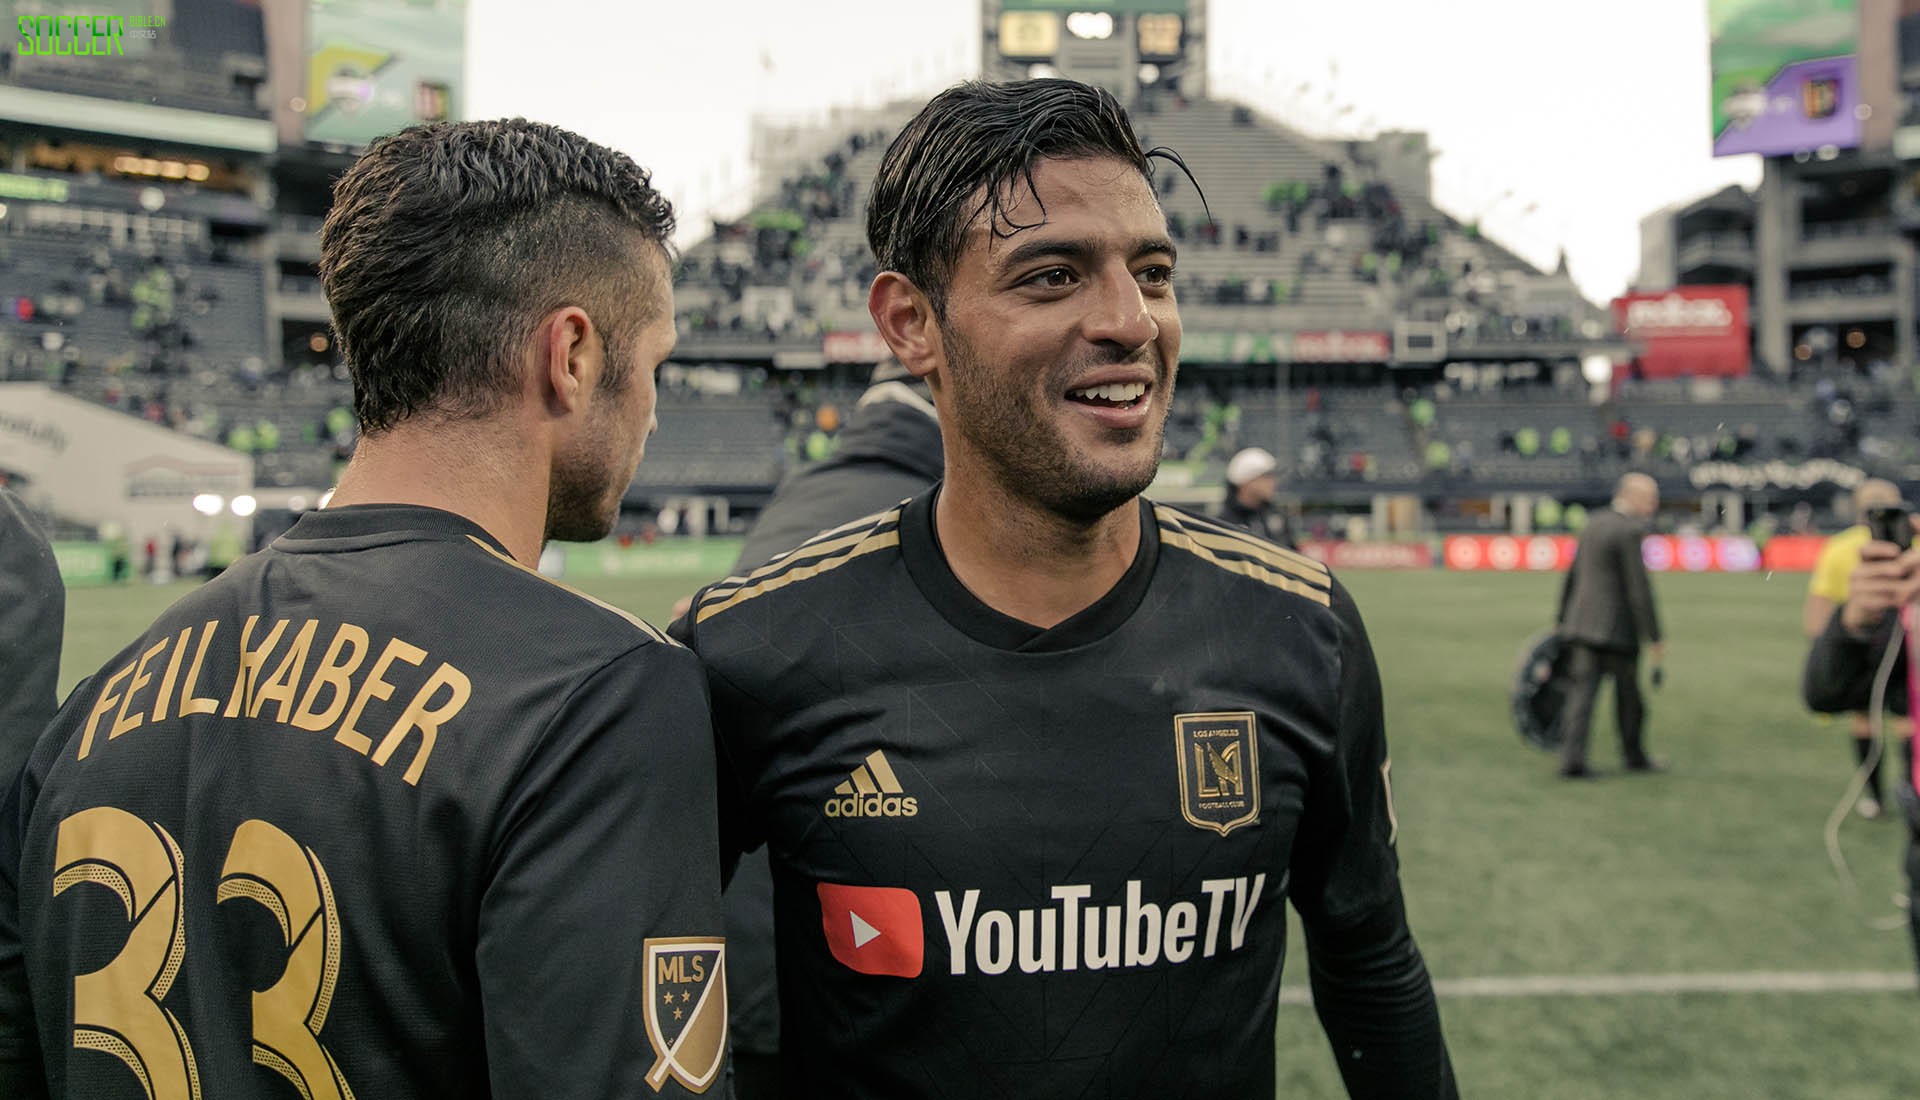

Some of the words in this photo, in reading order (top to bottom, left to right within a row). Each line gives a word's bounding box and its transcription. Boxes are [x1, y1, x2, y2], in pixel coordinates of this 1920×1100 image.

[78, 615, 471, 786] FEILHABER
[824, 792, 919, 817] adidas
[53, 806, 356, 1100] 33
[658, 955, 705, 985] MLS
